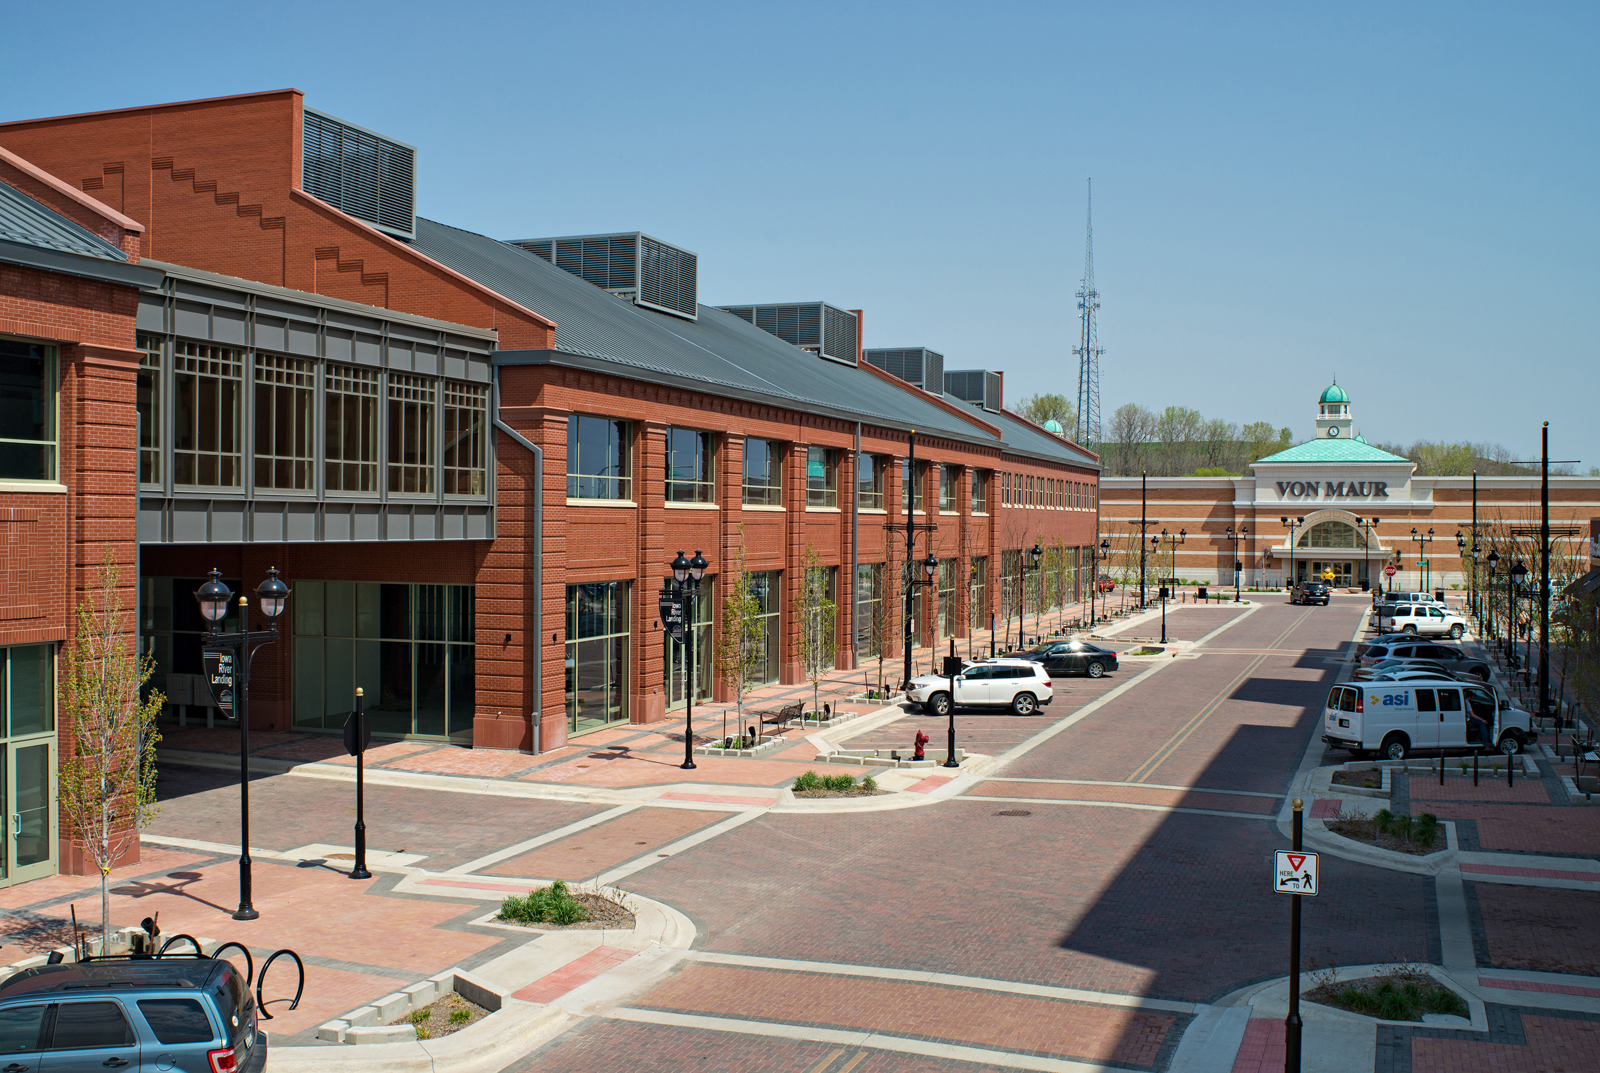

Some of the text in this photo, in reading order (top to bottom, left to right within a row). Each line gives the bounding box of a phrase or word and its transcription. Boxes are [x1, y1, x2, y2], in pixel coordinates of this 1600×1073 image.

[1276, 481, 1389, 497] VON MAUR
[666, 615, 681, 623] Landing
[220, 653, 232, 663] Iowa
[218, 663, 232, 673] River
[211, 674, 232, 687] Landing
[1382, 691, 1409, 706] asi
